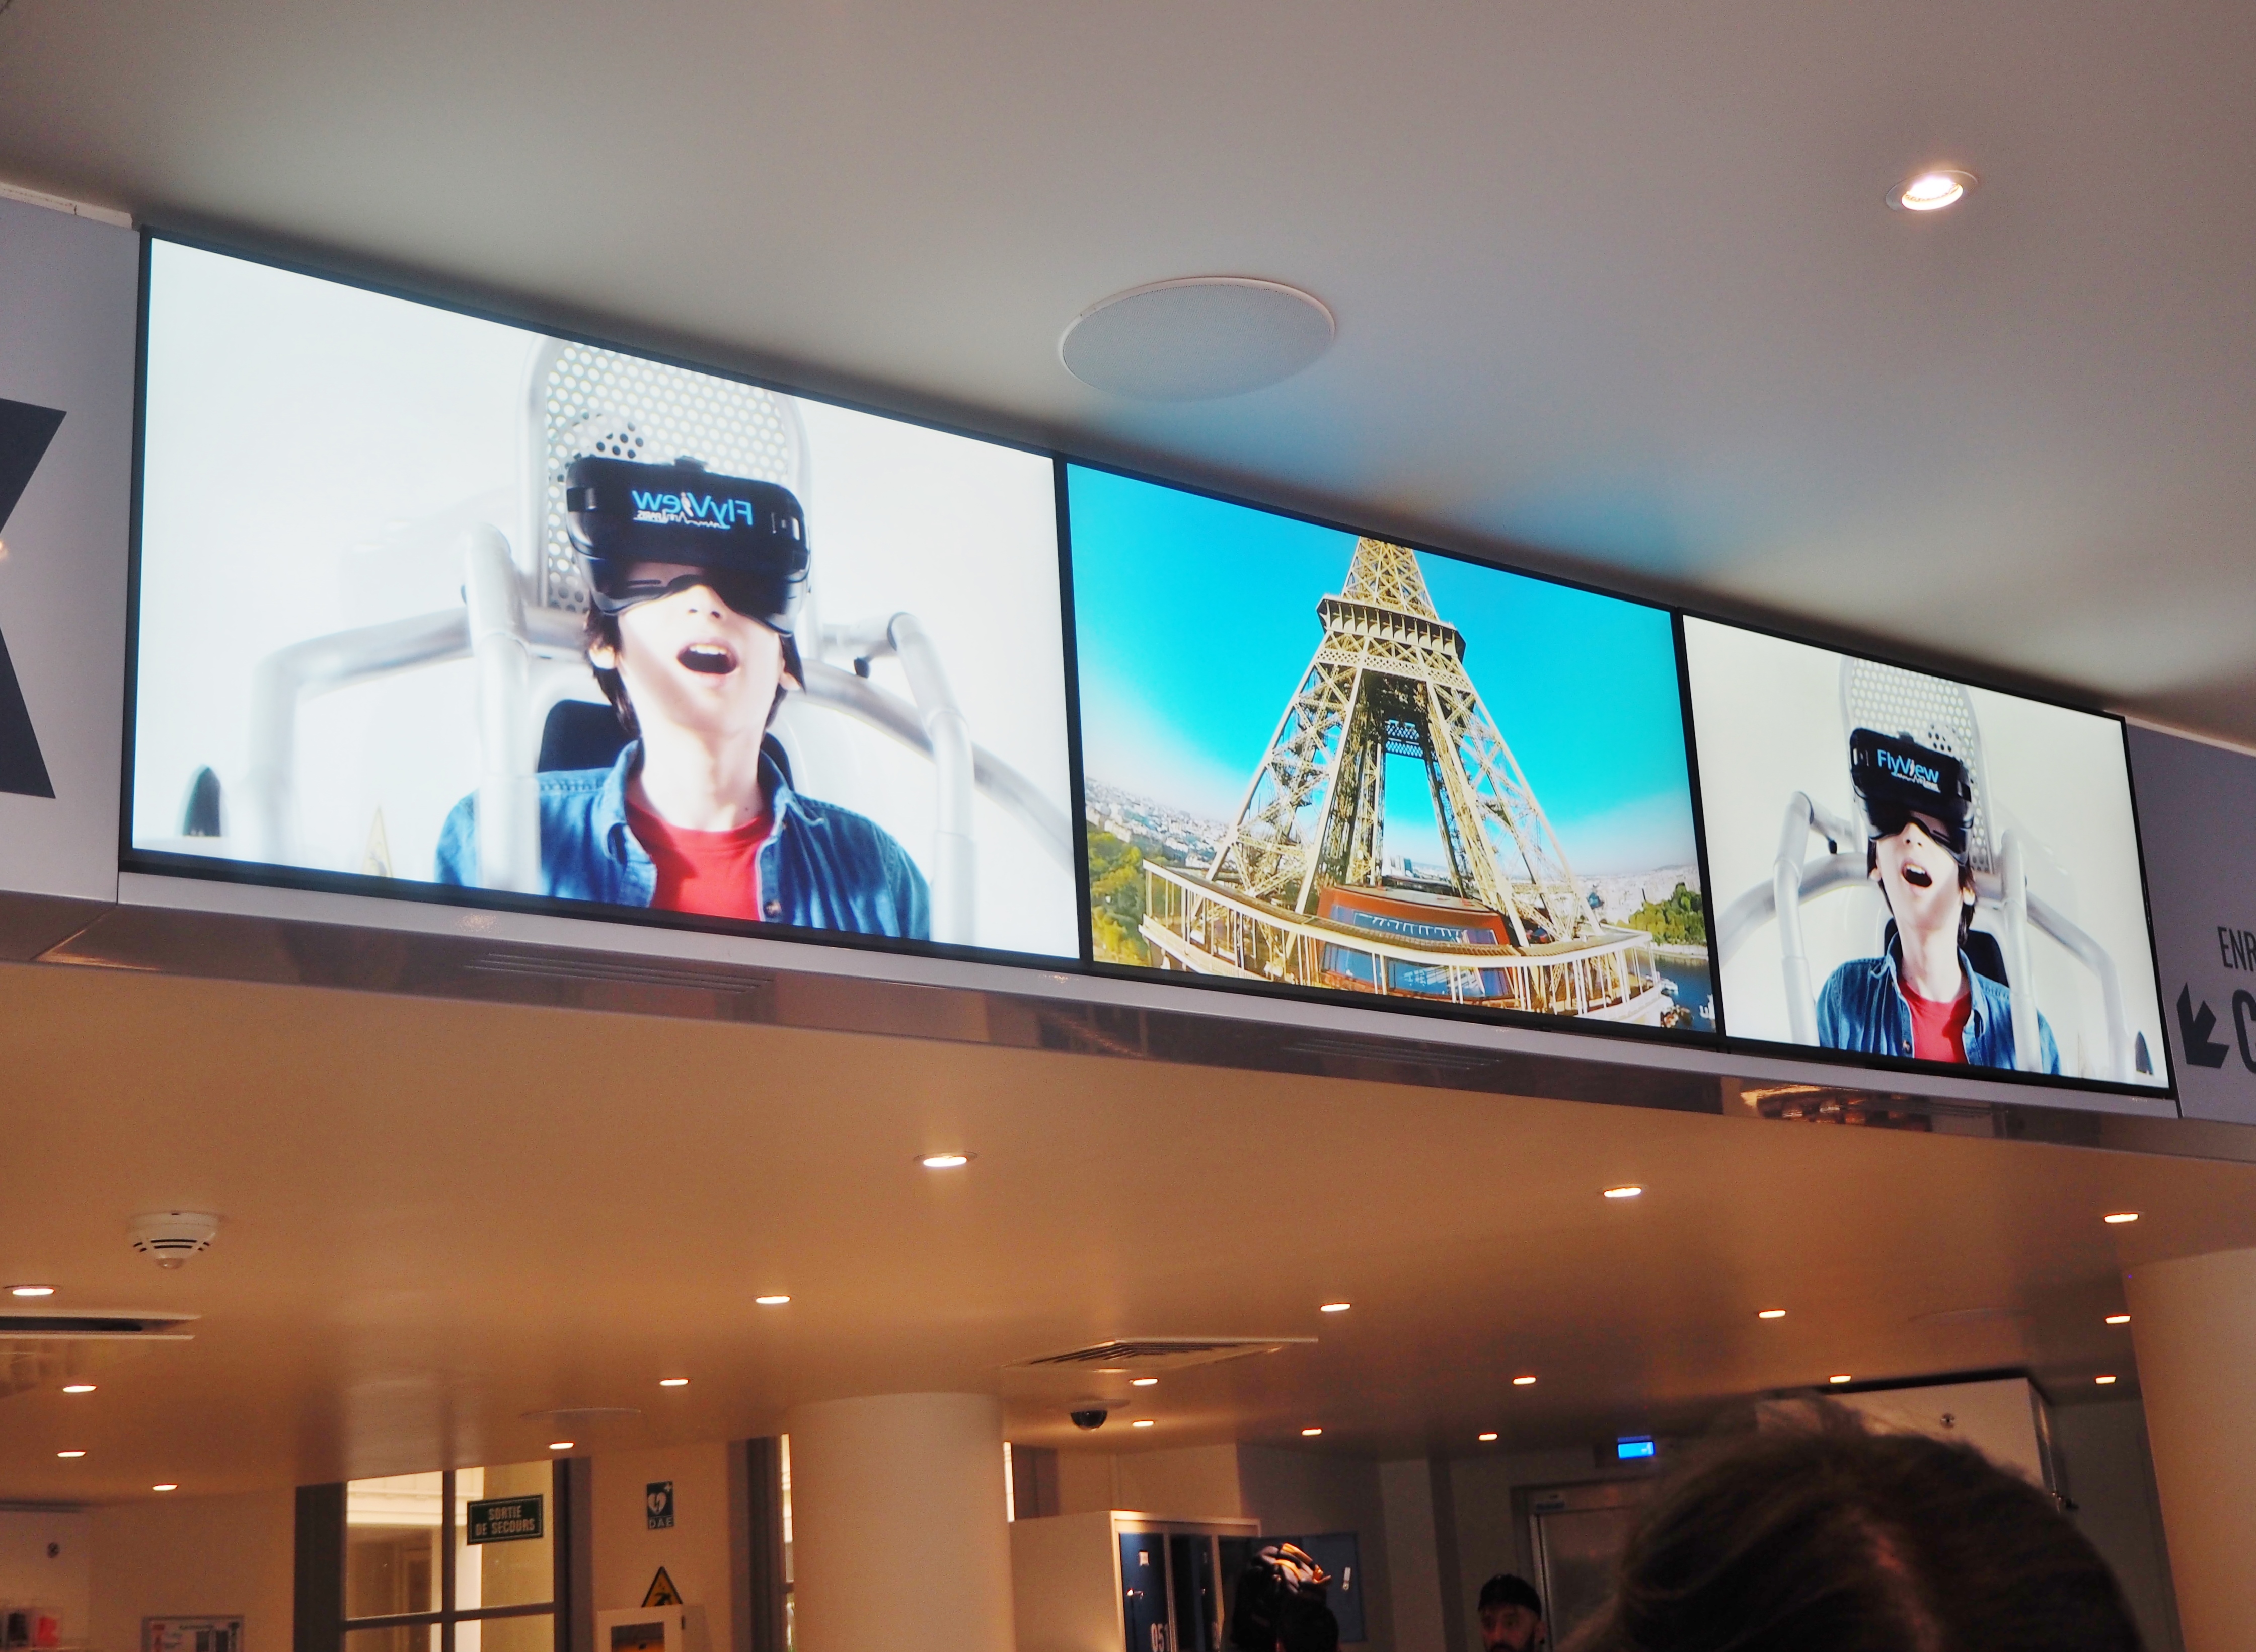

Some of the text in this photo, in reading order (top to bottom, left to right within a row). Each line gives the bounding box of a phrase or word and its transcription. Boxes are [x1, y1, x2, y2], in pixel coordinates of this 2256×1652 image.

[1877, 749, 1939, 783] FlyView
[489, 1506, 521, 1520] SORTIE
[476, 1518, 535, 1535] DE SECOURS
[649, 1517, 673, 1528] DAE
